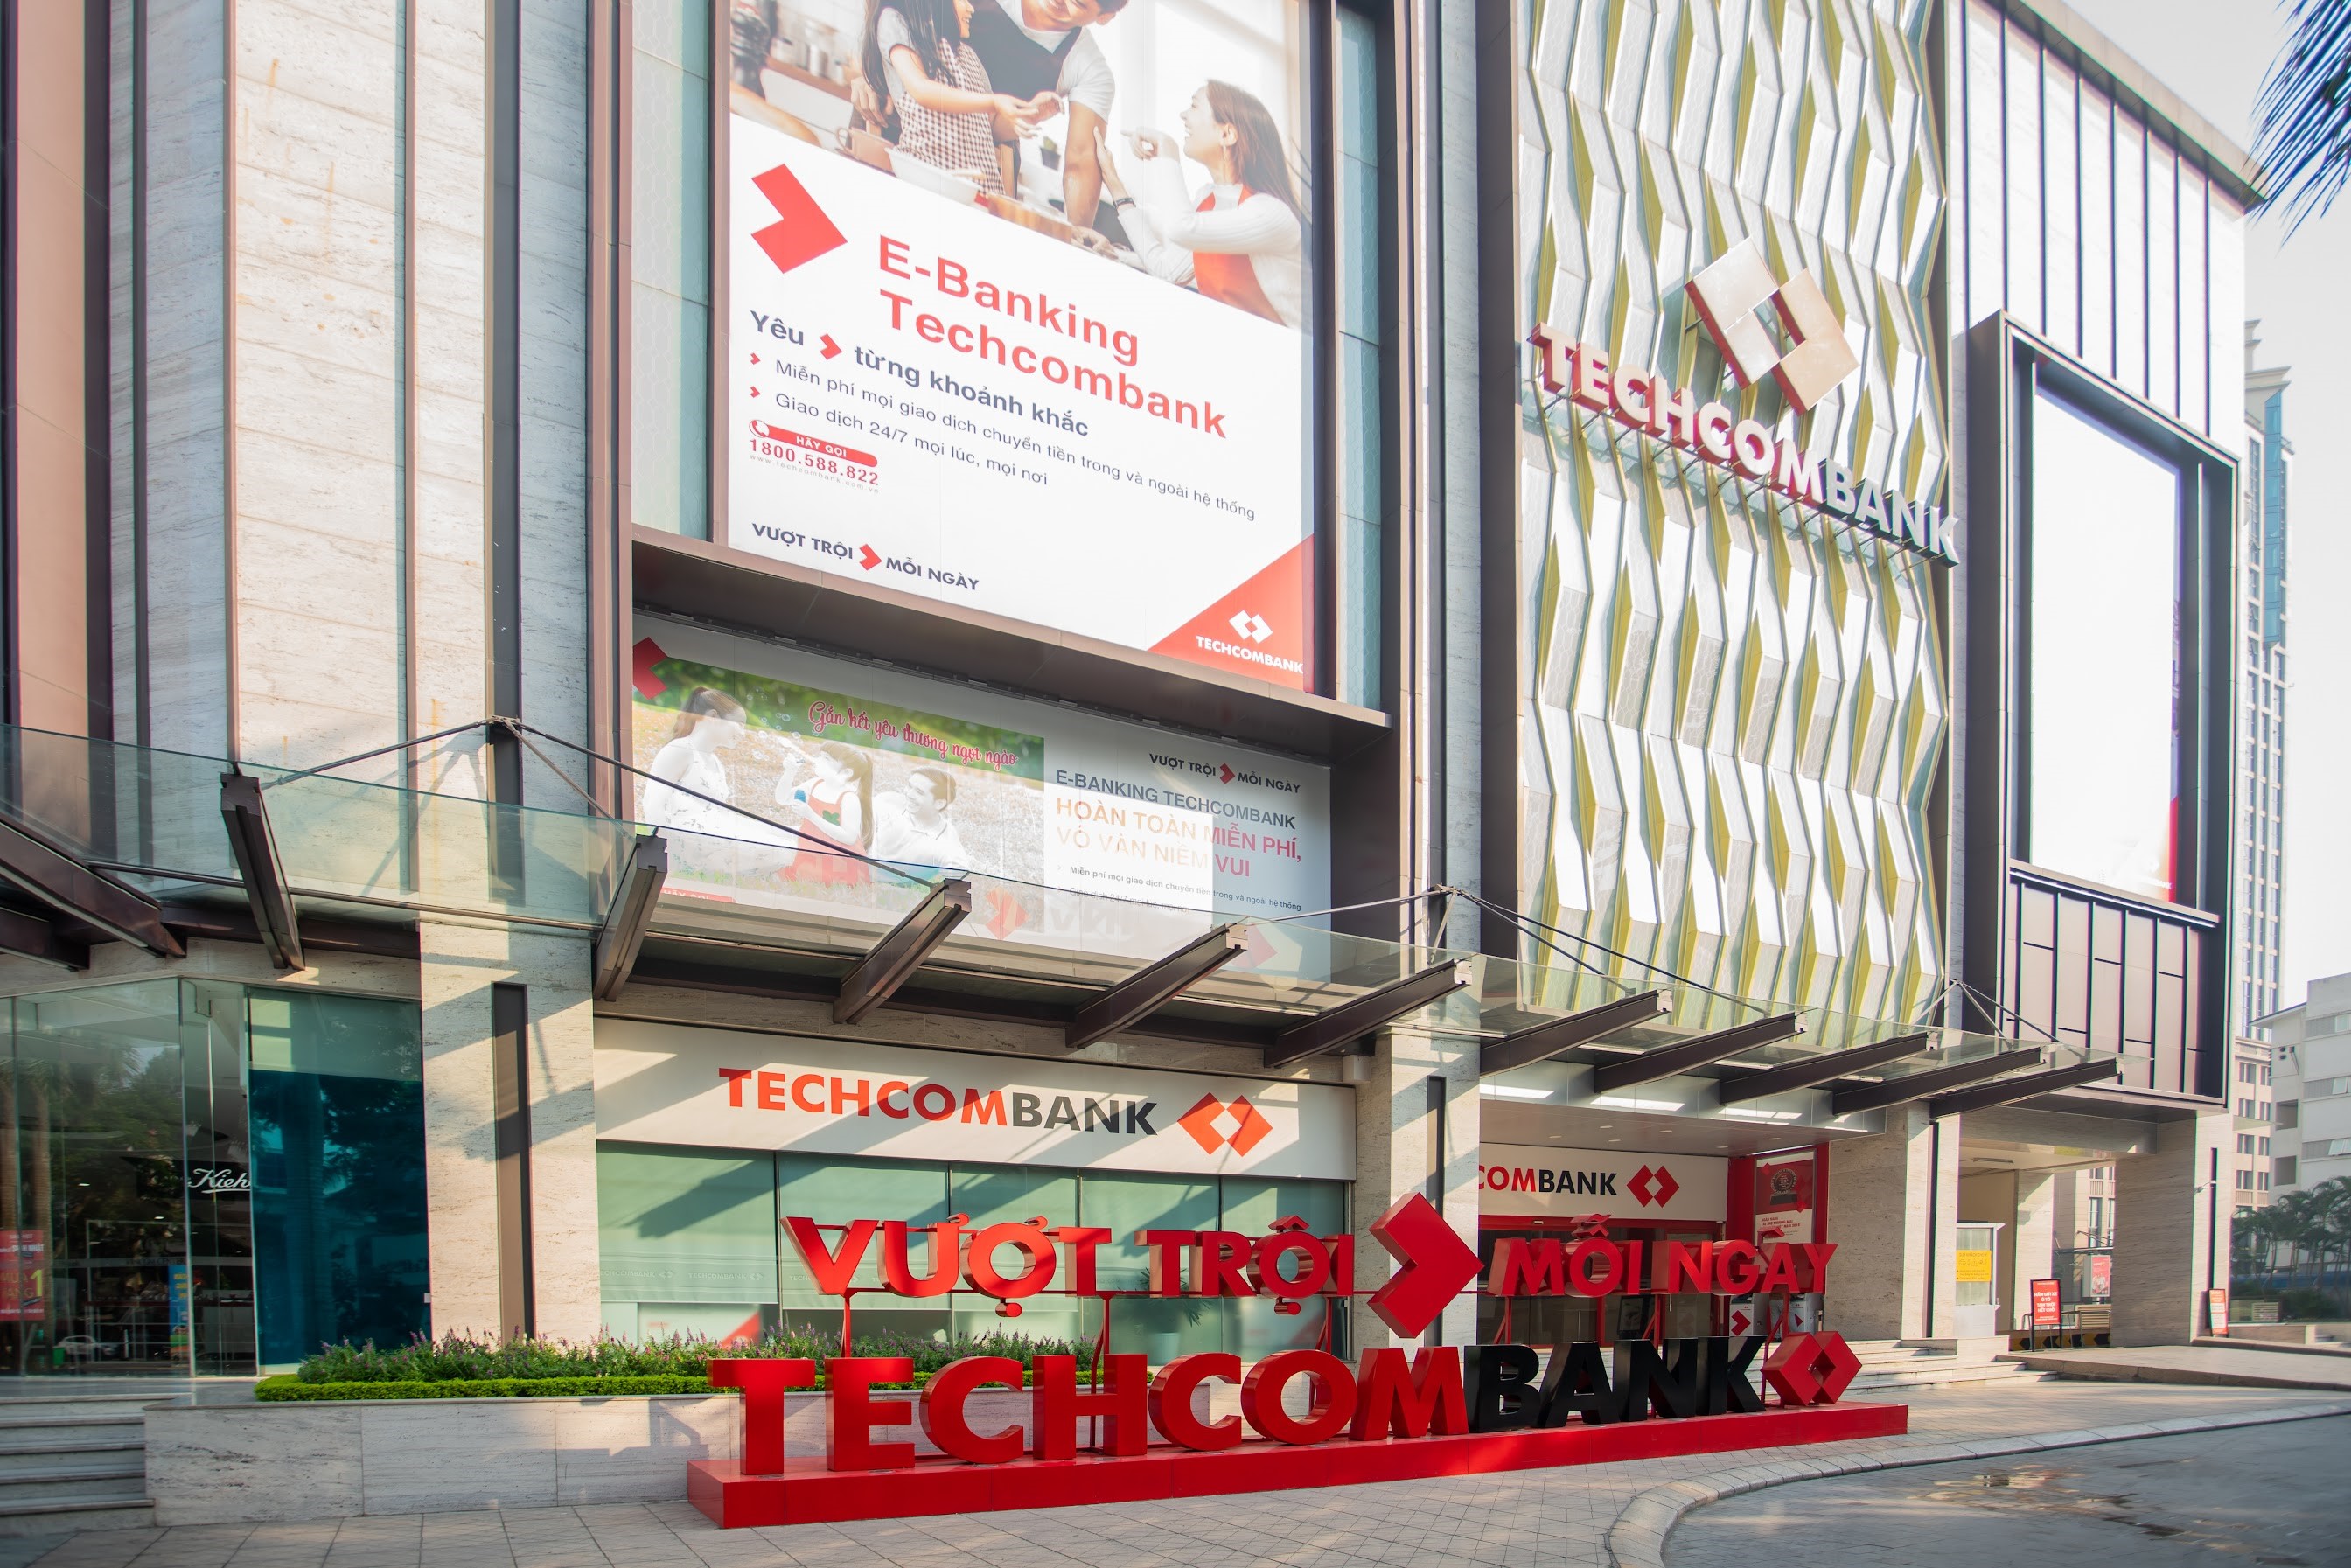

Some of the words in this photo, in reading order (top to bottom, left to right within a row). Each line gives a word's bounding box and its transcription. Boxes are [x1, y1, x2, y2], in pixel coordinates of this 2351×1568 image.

[880, 234, 1138, 366] E-Banking
[750, 310, 804, 346] Yêu
[854, 346, 920, 387] từng
[930, 370, 1022, 416] khoảnh
[1032, 403, 1089, 436] khắc
[880, 289, 1226, 438] Techcombank
[750, 438, 879, 486] 1800.588.822
[776, 394, 820, 417] Giao
[826, 409, 863, 430] dịch
[869, 422, 908, 443] 24/7
[914, 436, 945, 456] mọi
[952, 446, 980, 467] lúc,
[987, 458, 1015, 477] mọi
[1022, 467, 1048, 485] nơi
[776, 359, 820, 386] Miễn
[827, 378, 855, 396] phí
[862, 389, 893, 409] mọi
[899, 400, 936, 422] giao
[942, 414, 977, 435] dịch
[983, 426, 1041, 454] chuyển
[1047, 444, 1076, 464] tiền
[1081, 456, 1120, 481] trong
[1126, 470, 1143, 485] và
[1148, 478, 1189, 499] ngoài
[1194, 490, 1211, 507] hệ
[1216, 497, 1255, 522] thống
[796, 436, 821, 449] HÃY
[825, 444, 848, 458] GỌI
[1531, 322, 1959, 568] TECHCOMBANK
[752, 523, 806, 547] VƯỢT
[811, 537, 853, 560] TRỘI
[886, 556, 921, 577] MỖI
[928, 568, 980, 590] NGÀY
[1196, 635, 1303, 674] TECHCOMBANK
[848, 707, 870, 730] kết
[874, 720, 899, 741] yêu
[1056, 769, 1158, 804] E-BANKING
[1163, 791, 1296, 830] TECHCOMBANK
[1149, 753, 1185, 770] VƯỢT
[1188, 761, 1216, 777] TRỘI
[1238, 770, 1262, 786] MỖI
[1266, 777, 1301, 793] NGÀY
[1057, 797, 1126, 827] HOÀN
[1133, 812, 1196, 840] TOÀN
[1203, 822, 1256, 851] MIỄN
[1263, 837, 1302, 863] PHÍ,
[1092, 870, 1106, 879] phí
[1126, 876, 1144, 885] giao
[1146, 880, 1163, 889] dịch
[1213, 889, 1233, 902] trong
[1236, 892, 1245, 902] và
[1280, 900, 1301, 912] thống
[1215, 854, 1250, 877] VUI
[718, 1067, 1158, 1137] TECHCOMBANK
[780, 1213, 1112, 1318] VƯỢT
[1135, 1215, 1354, 1315] TRỘI
[1488, 1213, 1642, 1297] MỖI
[1654, 1226, 1838, 1296] NGÀY
[707, 1335, 1768, 1475] TECHCOMBANK
